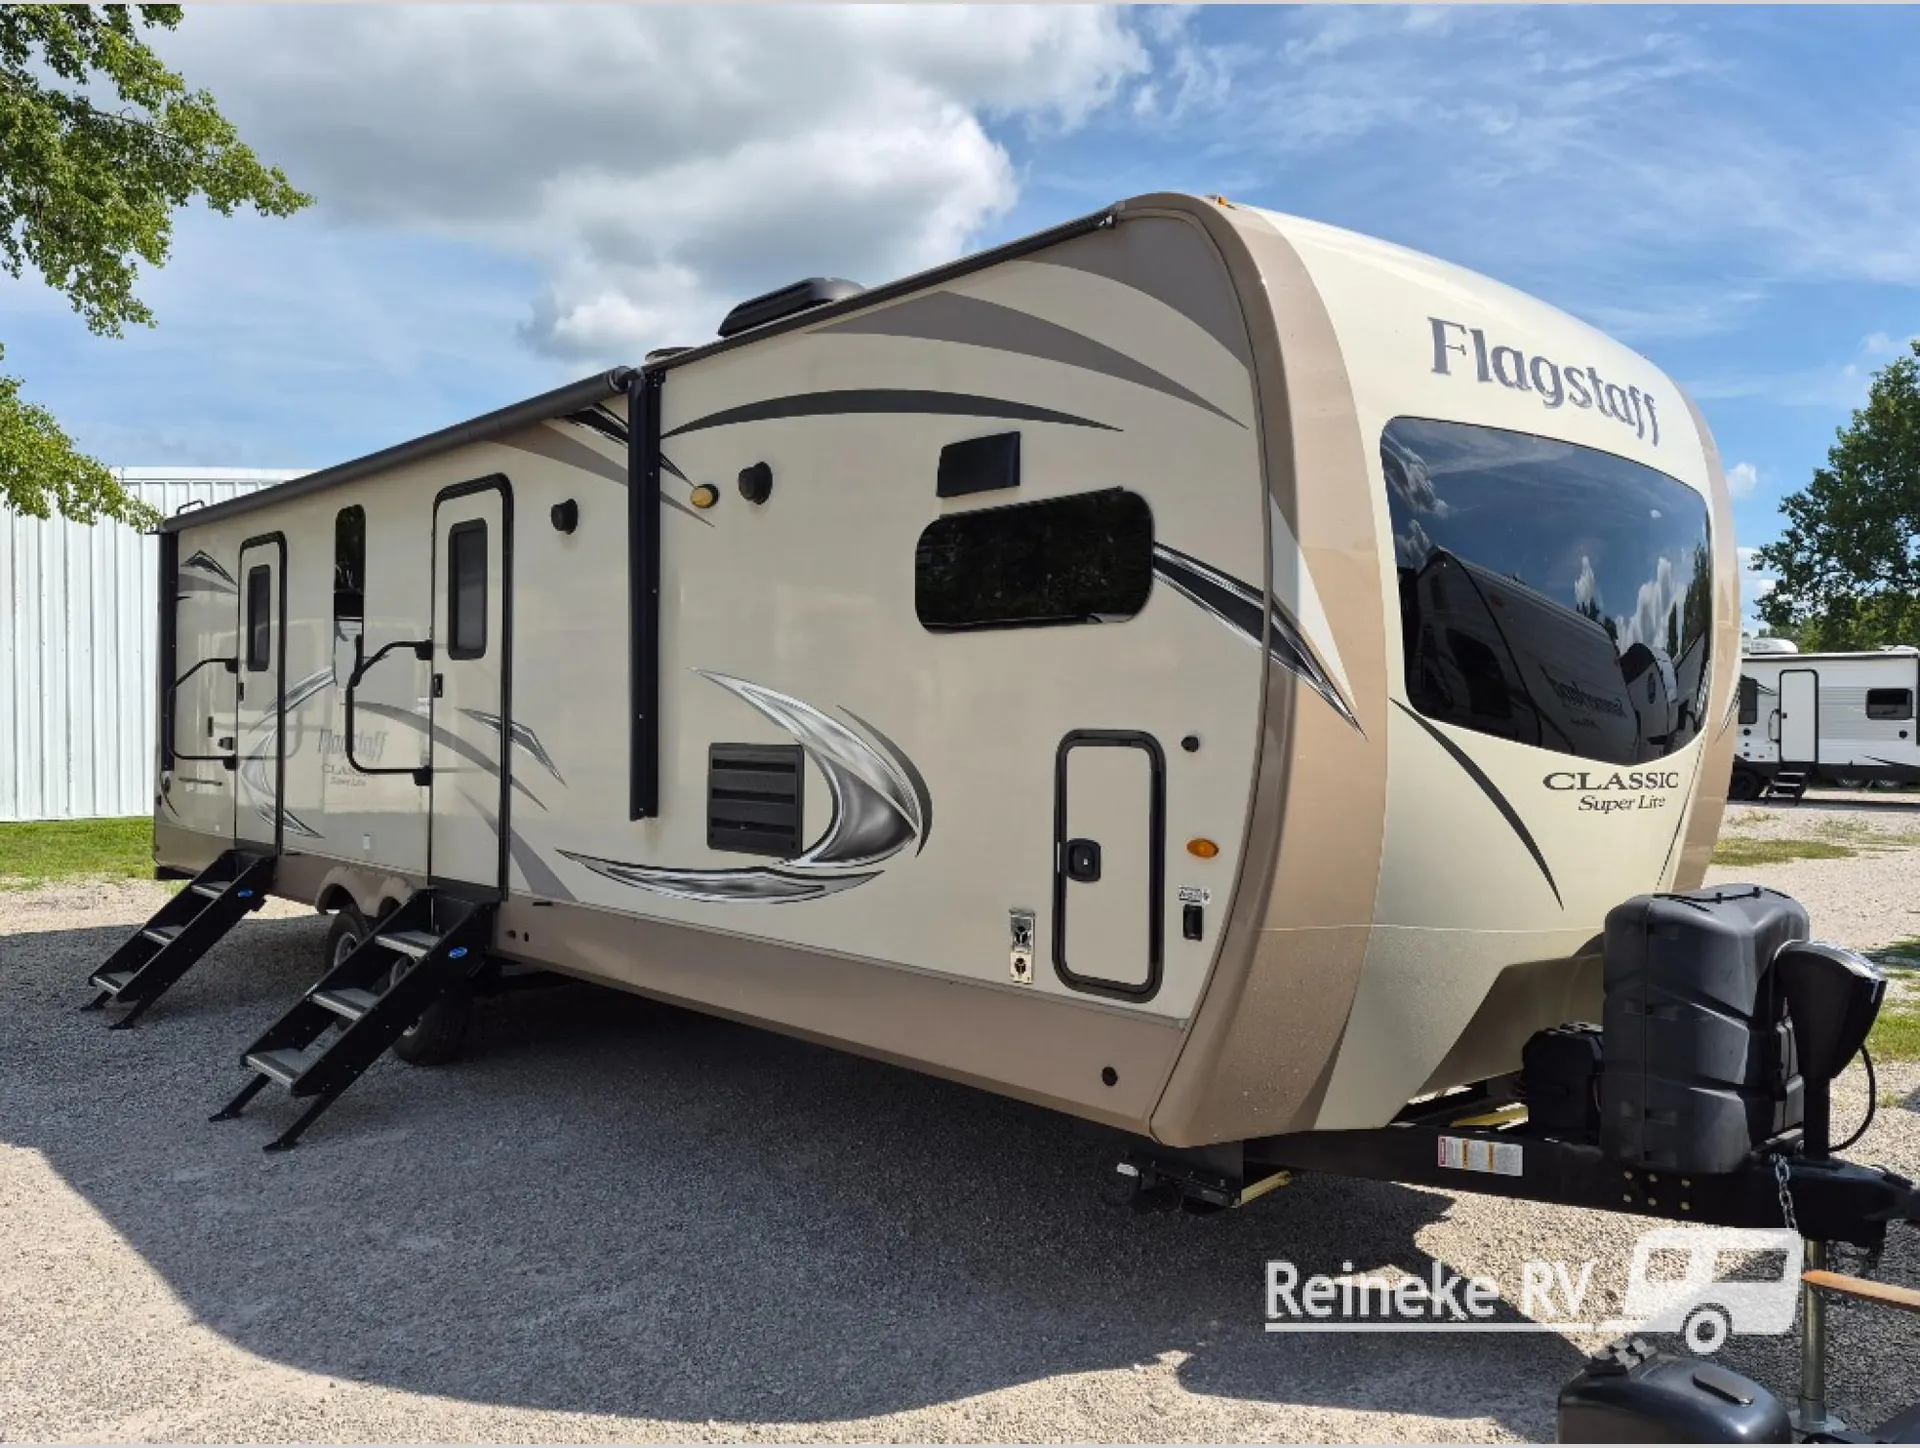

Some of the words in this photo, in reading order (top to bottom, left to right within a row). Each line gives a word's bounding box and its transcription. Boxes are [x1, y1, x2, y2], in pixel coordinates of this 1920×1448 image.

[1427, 316, 1659, 447] Flagstaff
[317, 728, 388, 762] Flataff
[1542, 772, 1679, 790] CLASSIC
[1578, 795, 1636, 814] Super
[1638, 795, 1666, 810] Lite
